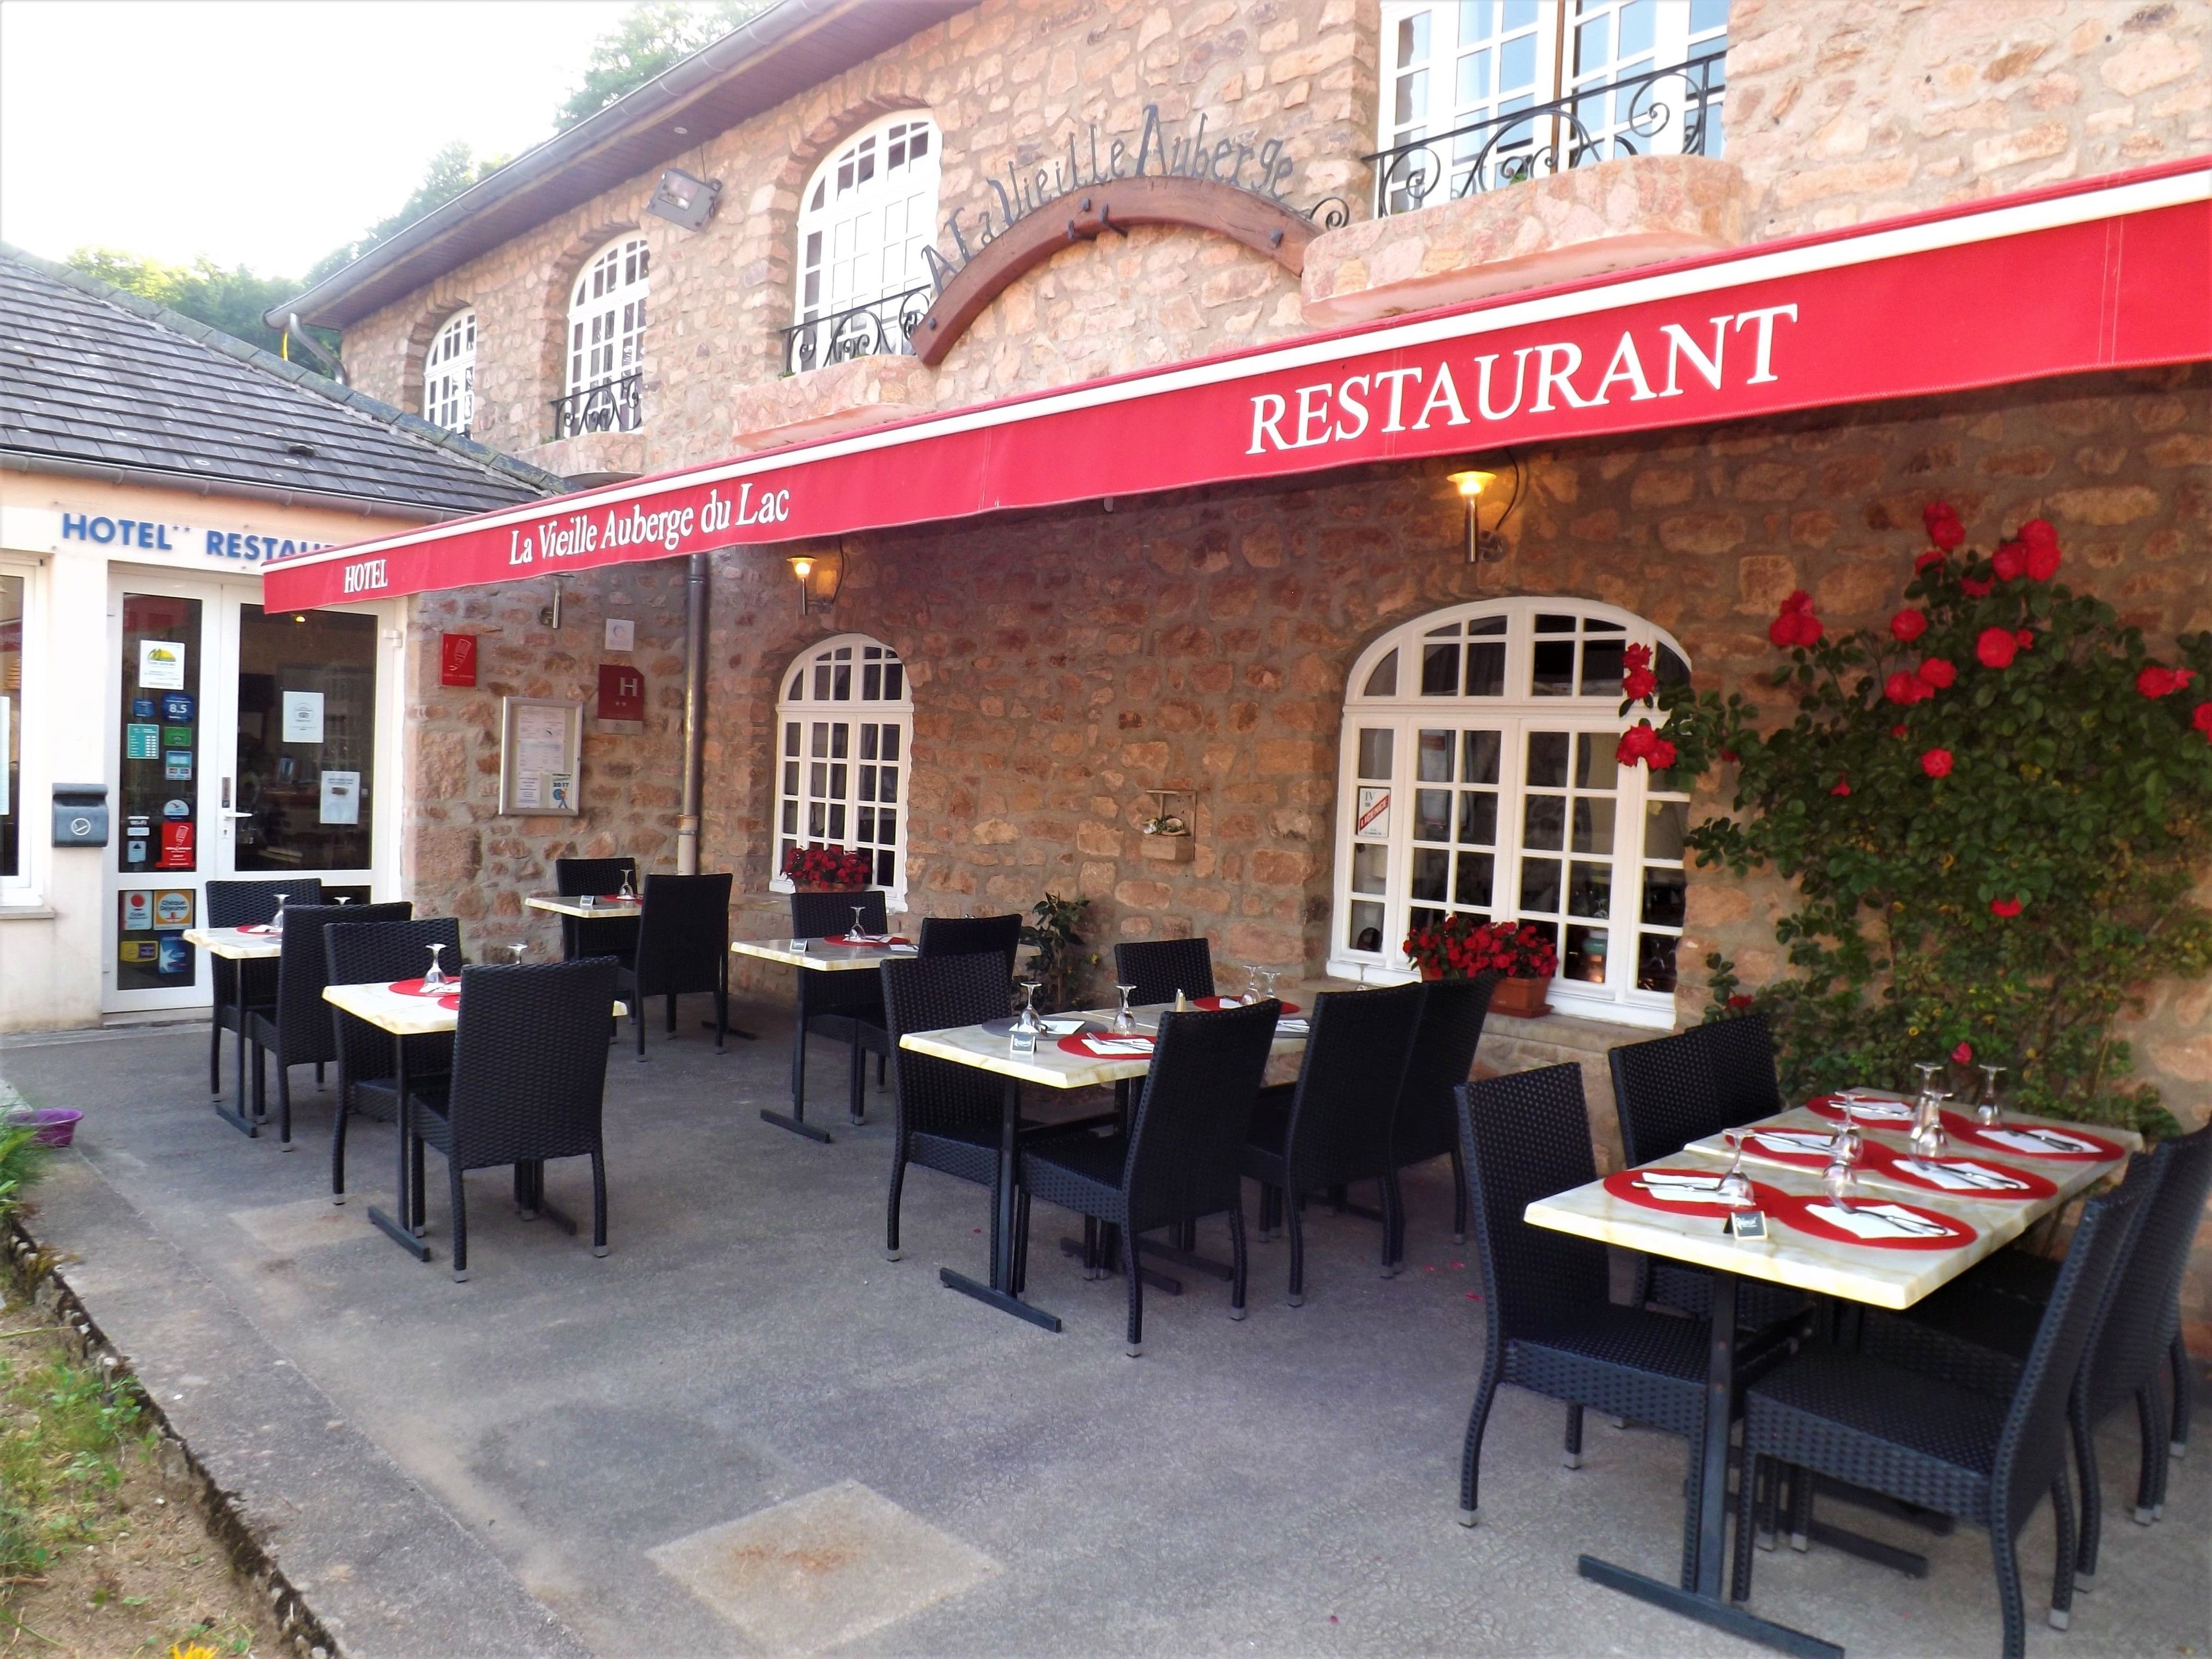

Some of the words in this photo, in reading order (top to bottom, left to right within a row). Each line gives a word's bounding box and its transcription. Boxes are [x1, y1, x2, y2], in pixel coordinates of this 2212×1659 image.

[986, 123, 1126, 228] Vieille
[1135, 102, 1293, 202] Auberge
[1245, 303, 1798, 455] RESTAURANT
[63, 512, 172, 550] HOTEL
[509, 529, 533, 565] La
[538, 514, 598, 559] Vieille
[600, 504, 694, 551] Auberge
[700, 488, 731, 533] du
[734, 483, 790, 526] Lac
[343, 559, 388, 593] HOTEL
[619, 677, 638, 697] H
[169, 704, 187, 713] 8.5
